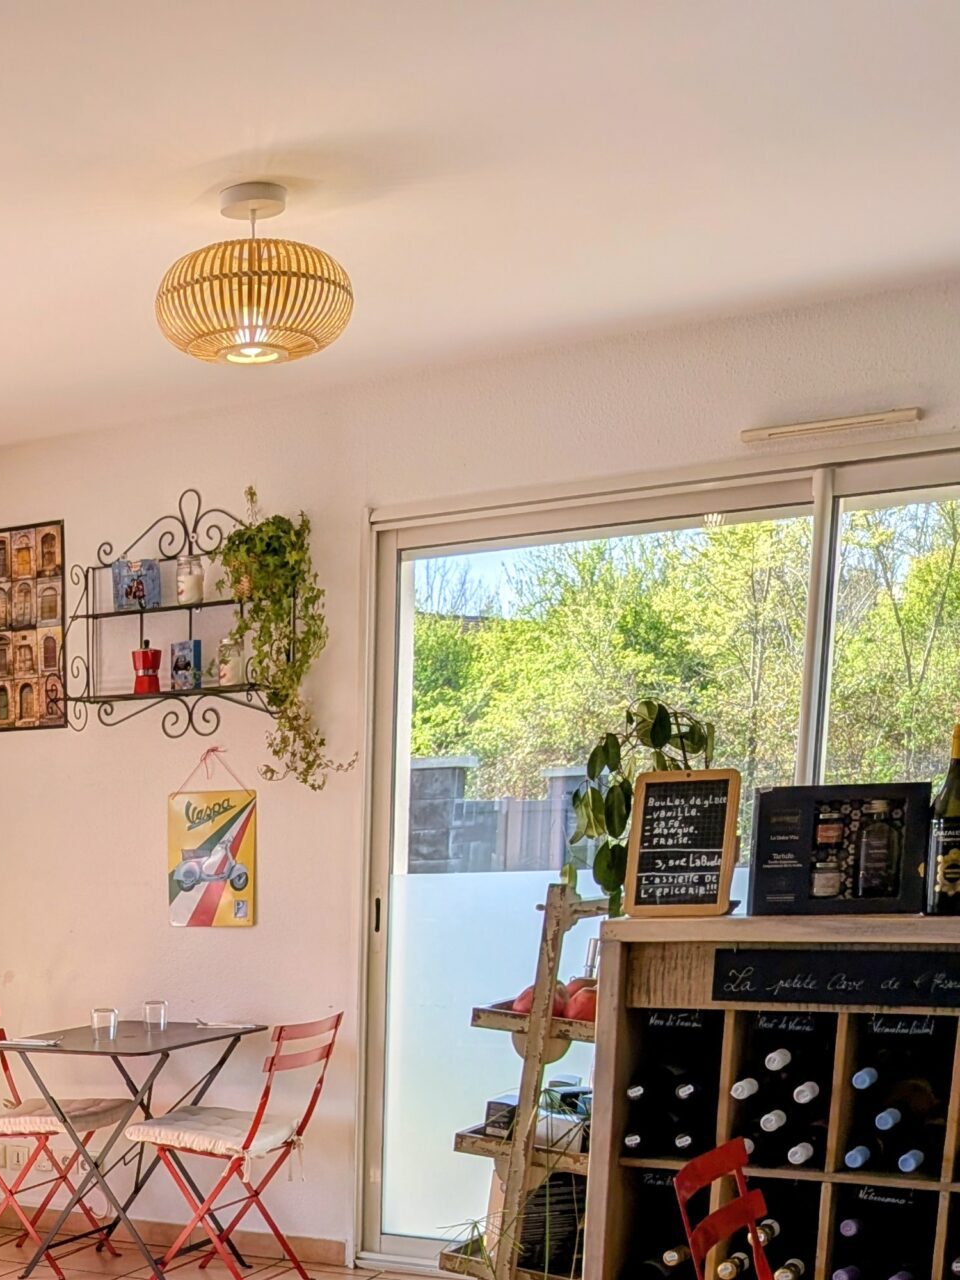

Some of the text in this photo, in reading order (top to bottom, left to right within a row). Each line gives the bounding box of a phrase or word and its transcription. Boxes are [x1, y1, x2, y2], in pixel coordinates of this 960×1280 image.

[185, 797, 237, 831] Vespa
[724, 966, 756, 992] La
[766, 974, 817, 995] petite
[880, 976, 899, 990] de
